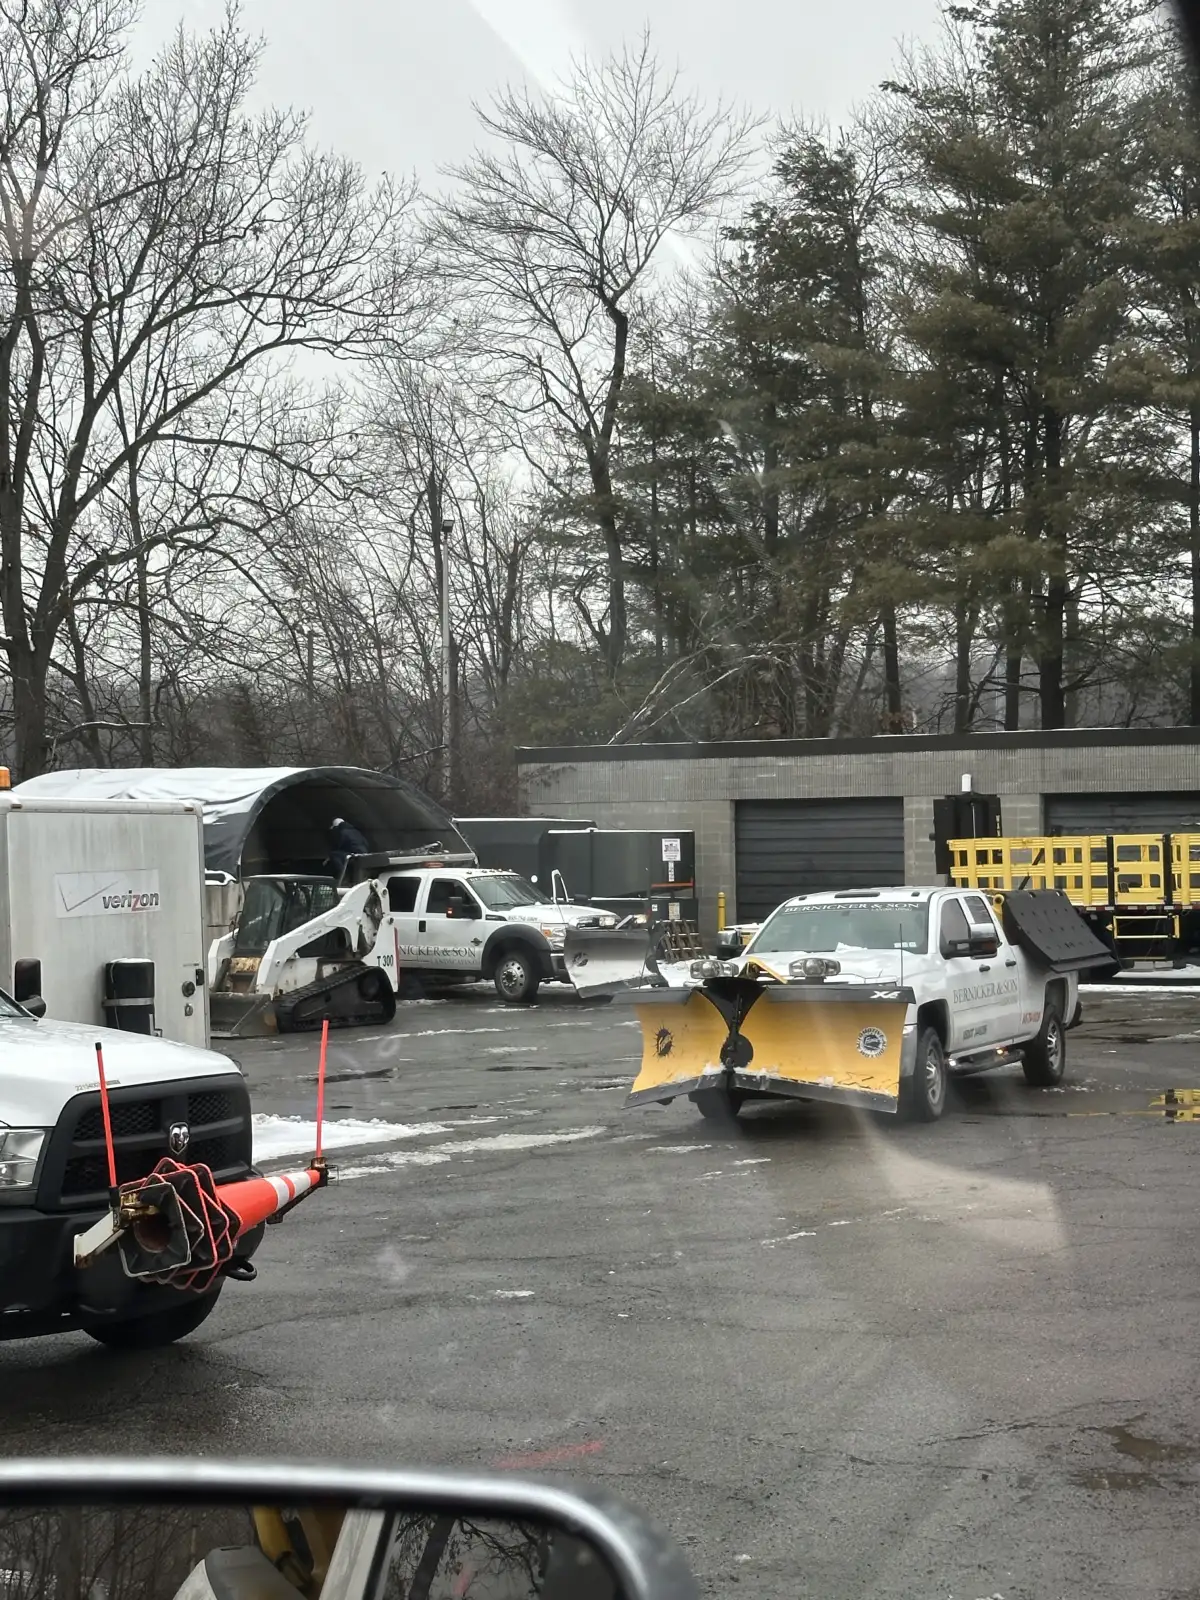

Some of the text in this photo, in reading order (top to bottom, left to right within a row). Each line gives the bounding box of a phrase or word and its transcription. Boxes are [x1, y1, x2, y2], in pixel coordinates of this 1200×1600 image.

[102, 889, 159, 911] verizon
[784, 902, 868, 913] BERNICKER
[399, 945, 476, 958] NICKER & SON
[376, 954, 394, 967] T 300
[953, 982, 996, 1004] BERNICKER
[996, 982, 1003, 995] &
[1003, 978, 1018, 994] SON
